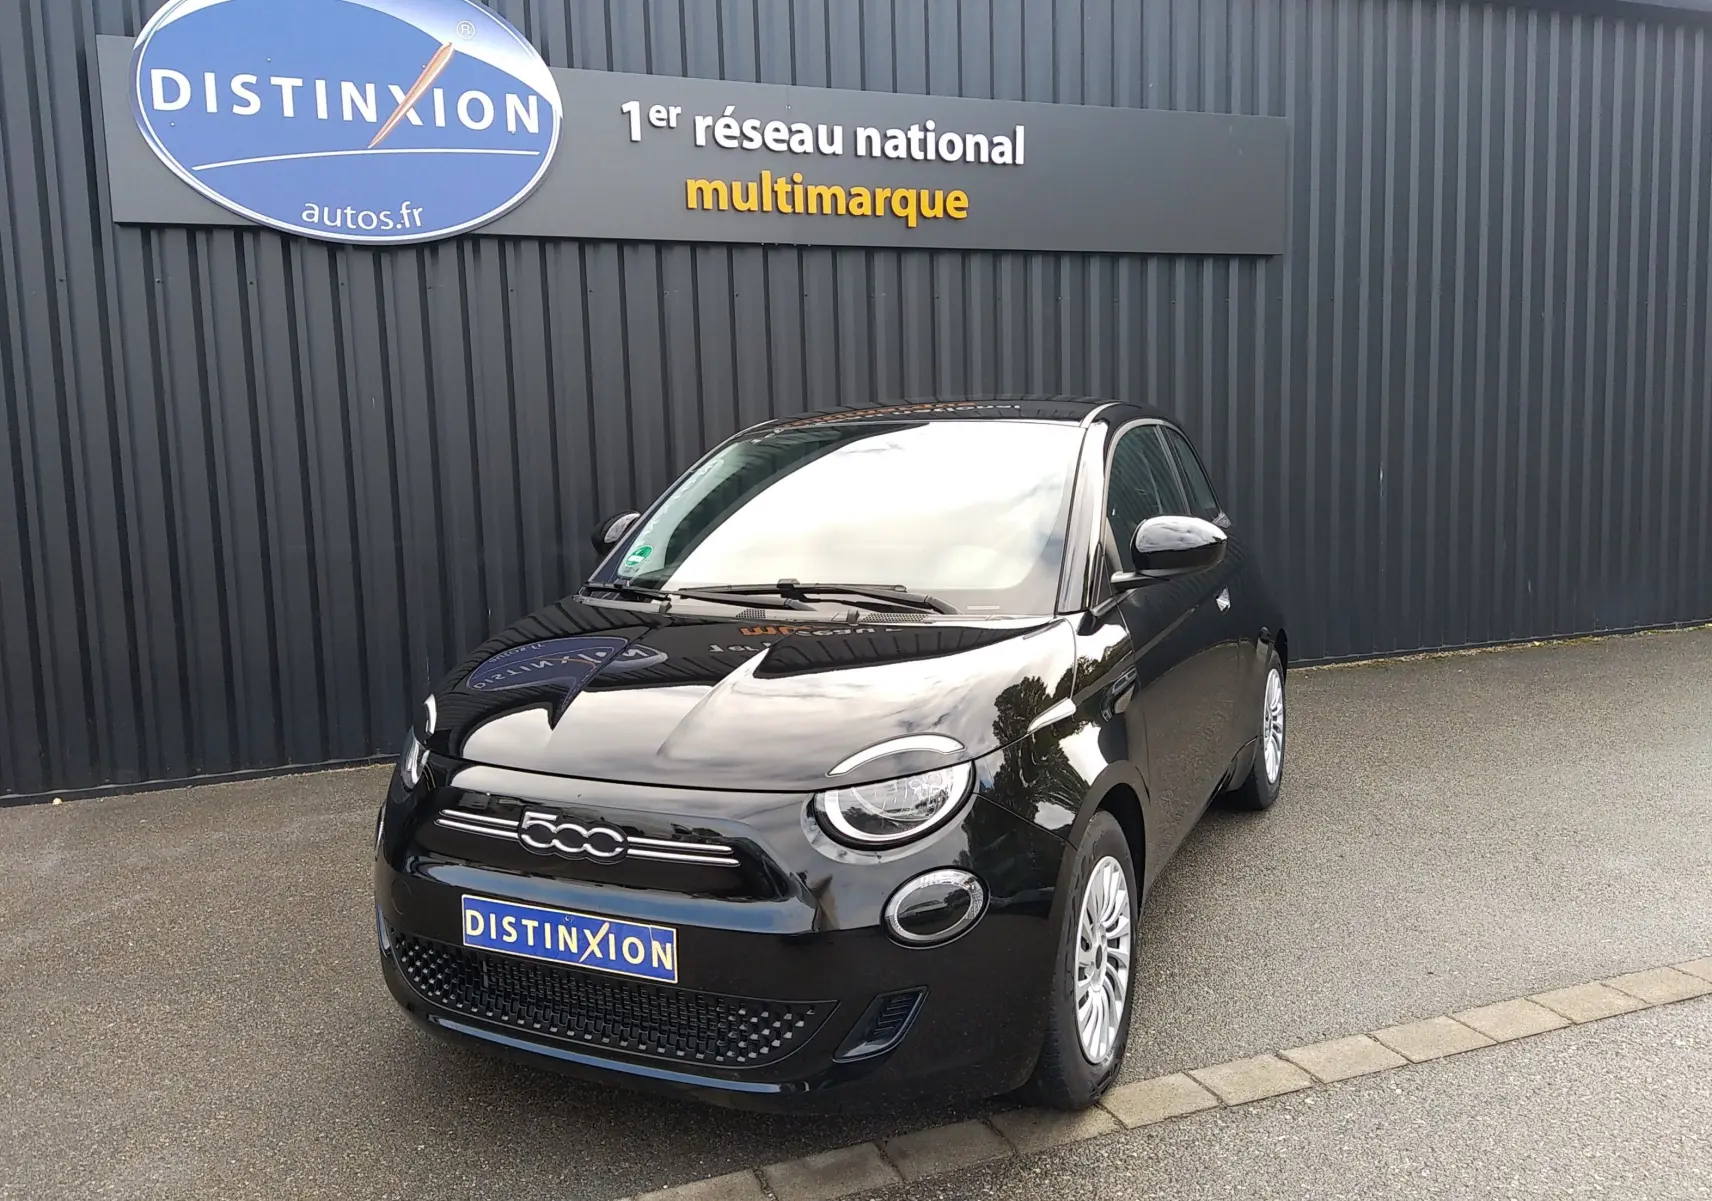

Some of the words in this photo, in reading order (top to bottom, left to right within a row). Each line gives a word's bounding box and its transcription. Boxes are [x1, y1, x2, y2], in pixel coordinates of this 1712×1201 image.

[149, 42, 541, 148] DISTINXION
[694, 105, 844, 155] réseau
[856, 120, 1026, 165] national
[302, 201, 424, 231] autos.fr
[686, 169, 970, 228] multimarque
[520, 811, 625, 858] 500
[464, 909, 674, 971] DISTINXION
